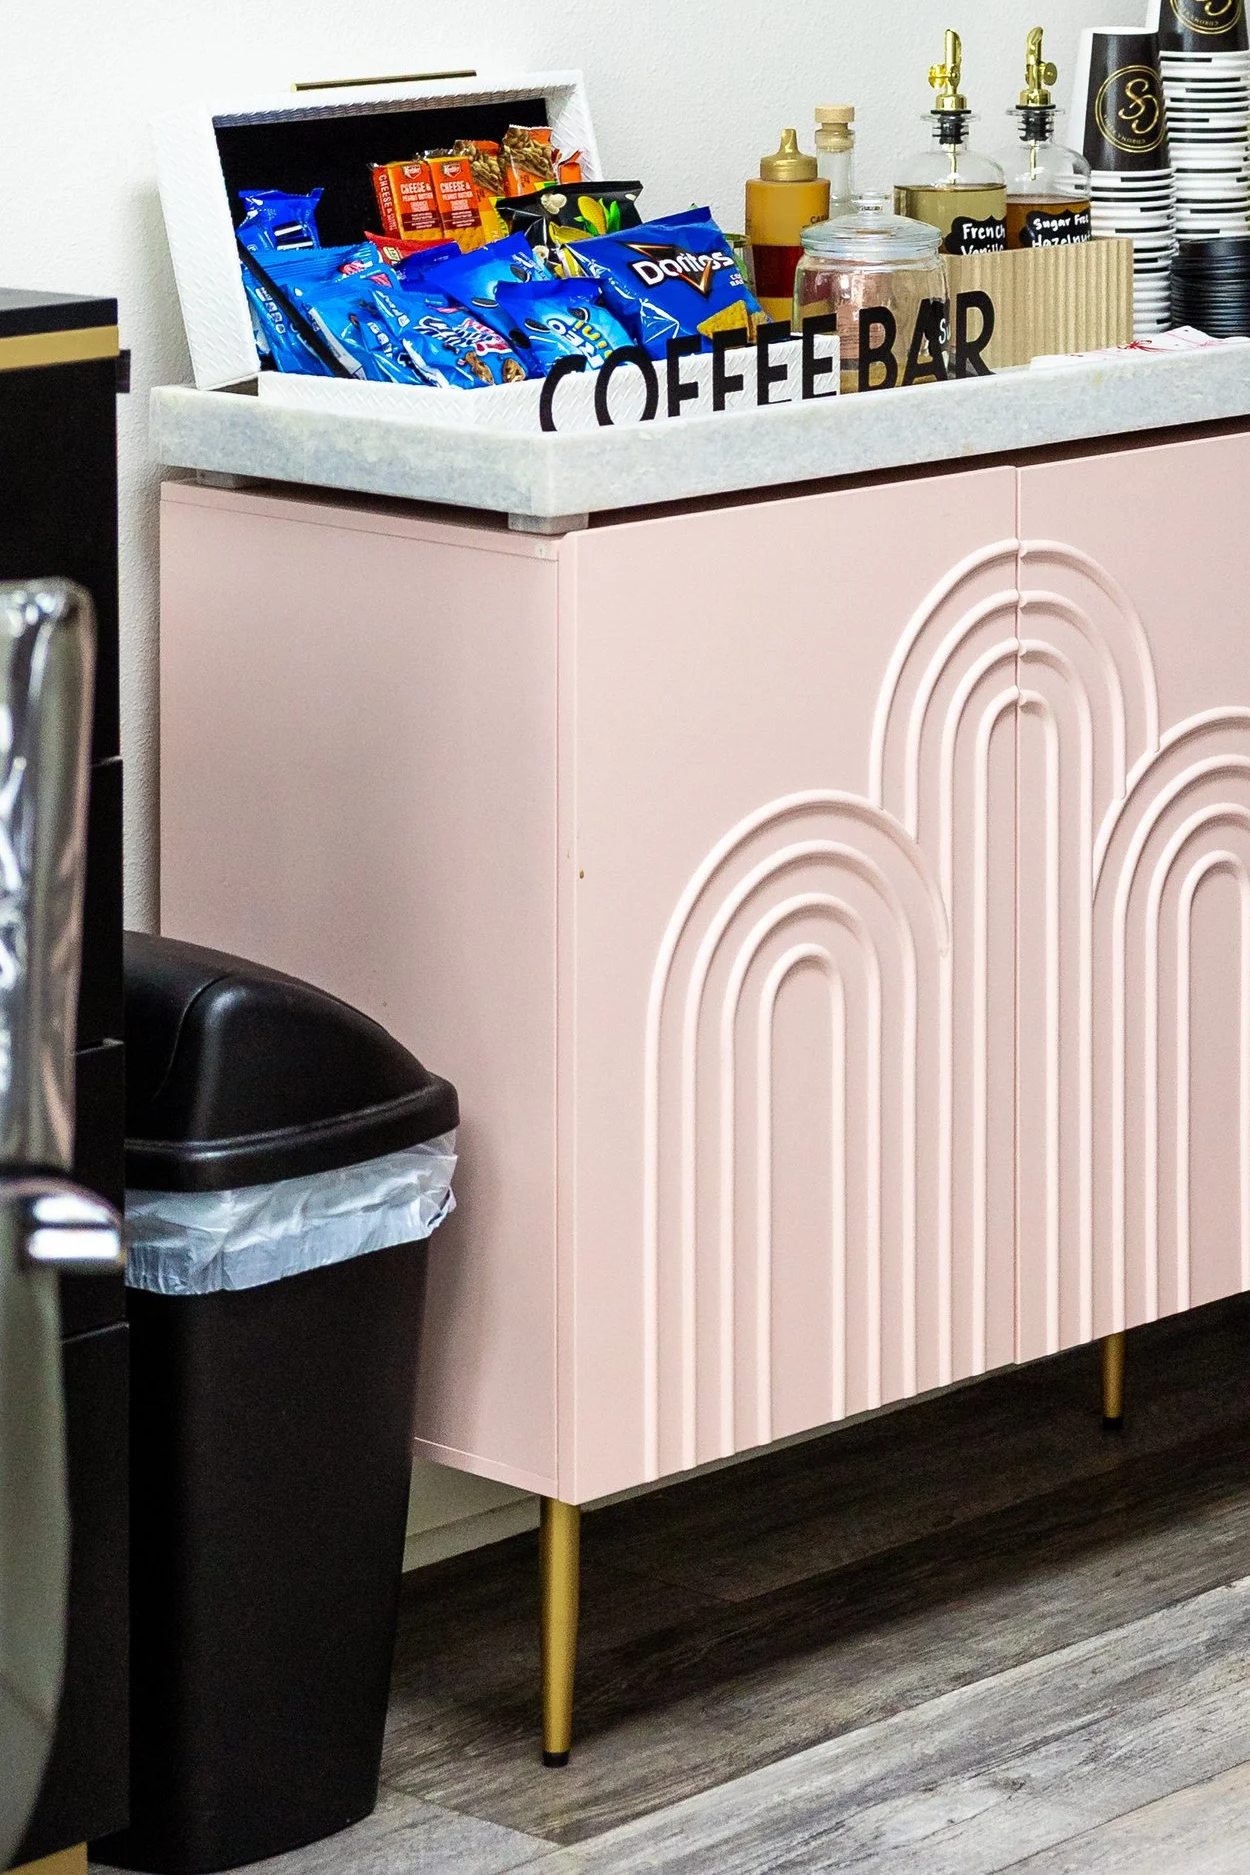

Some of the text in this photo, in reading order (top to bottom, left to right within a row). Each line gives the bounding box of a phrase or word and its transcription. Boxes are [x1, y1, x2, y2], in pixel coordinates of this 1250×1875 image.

[378, 174, 392, 209] CHEESE
[400, 182, 425, 194] CHEESE
[440, 180, 465, 194] CHEESE
[962, 223, 1005, 240] French
[1033, 217, 1071, 232] Sugar
[632, 251, 735, 286] Doritos
[546, 318, 605, 369] REO
[539, 290, 995, 432] COFFEE BAR
